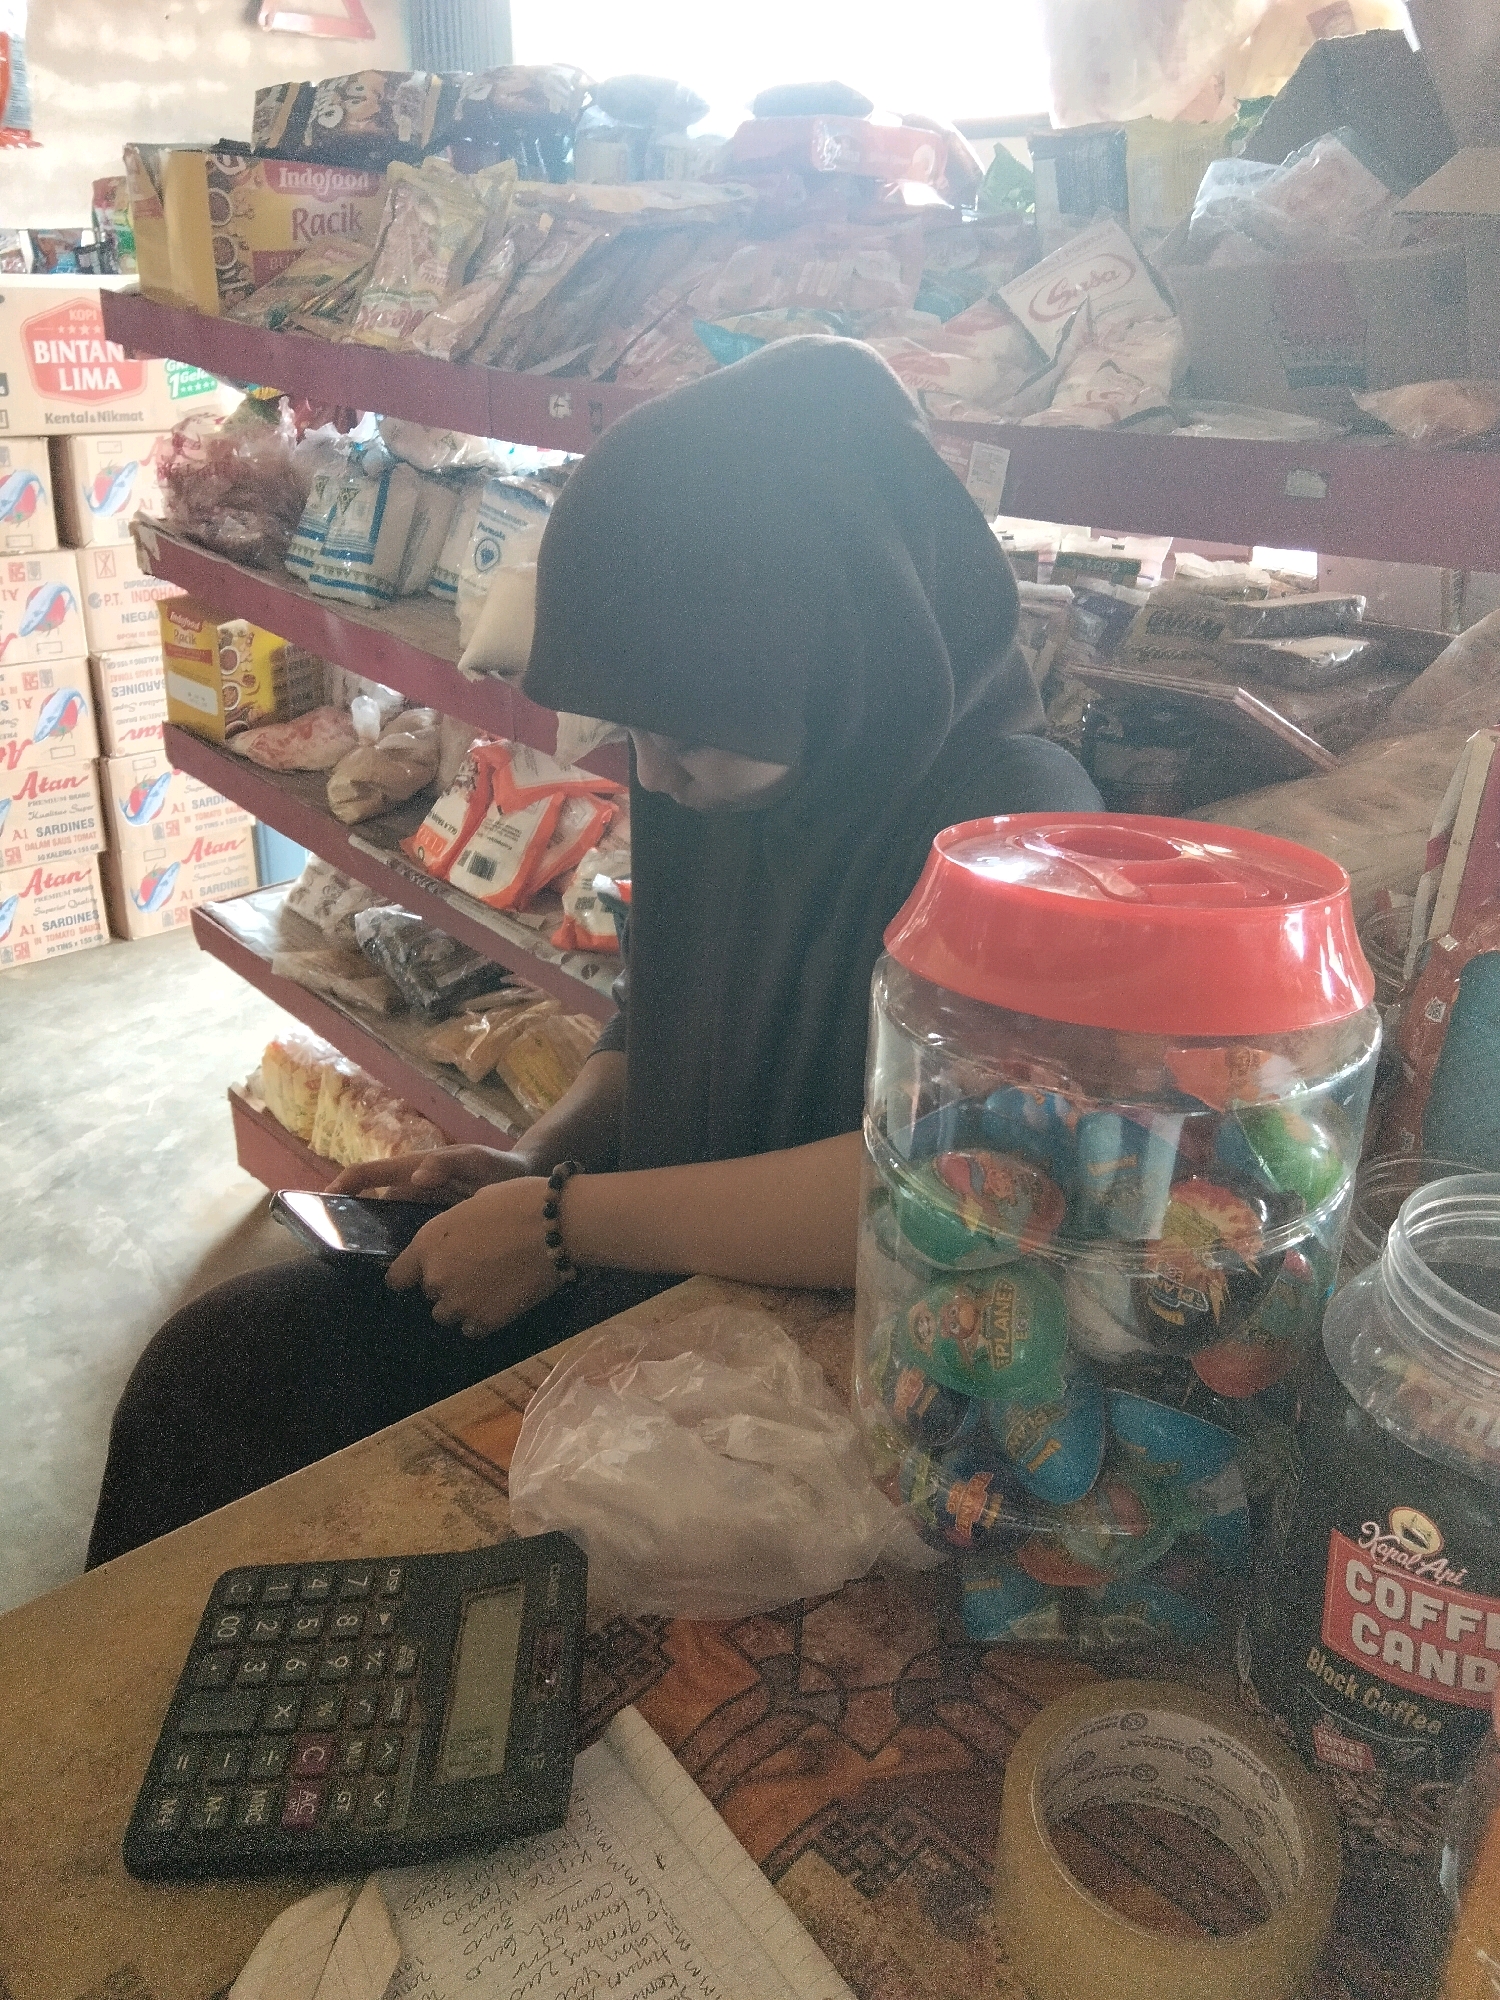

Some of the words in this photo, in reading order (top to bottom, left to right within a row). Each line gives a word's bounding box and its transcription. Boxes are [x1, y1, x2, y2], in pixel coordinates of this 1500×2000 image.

[278, 167, 370, 196] Indofood
[291, 202, 364, 242] Racik
[69, 308, 97, 321] KOPI
[58, 367, 122, 392] LIMA
[44, 411, 90, 424] Kental
[97, 409, 144, 421] Nikmat
[104, 592, 123, 606] P.T.
[173, 628, 197, 645] Racik
[12, 771, 89, 800] Atan
[172, 803, 186, 815] A1
[12, 829, 29, 842] A1
[36, 818, 95, 838] SARDINES
[25, 840, 50, 851] DALAM
[181, 837, 246, 865] Atan
[19, 868, 92, 898] Atan
[180, 890, 194, 901] A1
[200, 877, 249, 896] SARDINES
[20, 925, 36, 938] A1
[43, 909, 100, 932] SARDINES
[1359, 1521, 1421, 1570] Kapal
[267, 1583, 288, 1591] 1
[307, 1578, 328, 1589] 4
[347, 1577, 368, 1588] 7
[386, 1568, 403, 1592] DISP
[216, 1616, 240, 1638] 00
[255, 1619, 277, 1632] 2
[297, 1618, 318, 1630] 5
[336, 1614, 358, 1627] 8
[243, 1660, 265, 1673] 3
[285, 1658, 306, 1671] 6
[327, 1656, 348, 1668] 9
[1306, 1646, 1359, 1700] Black
[1361, 1688, 1442, 1735] Coffee
[301, 1745, 325, 1764] C
[243, 1790, 270, 1823] MRC
[299, 1790, 315, 1815] AC
